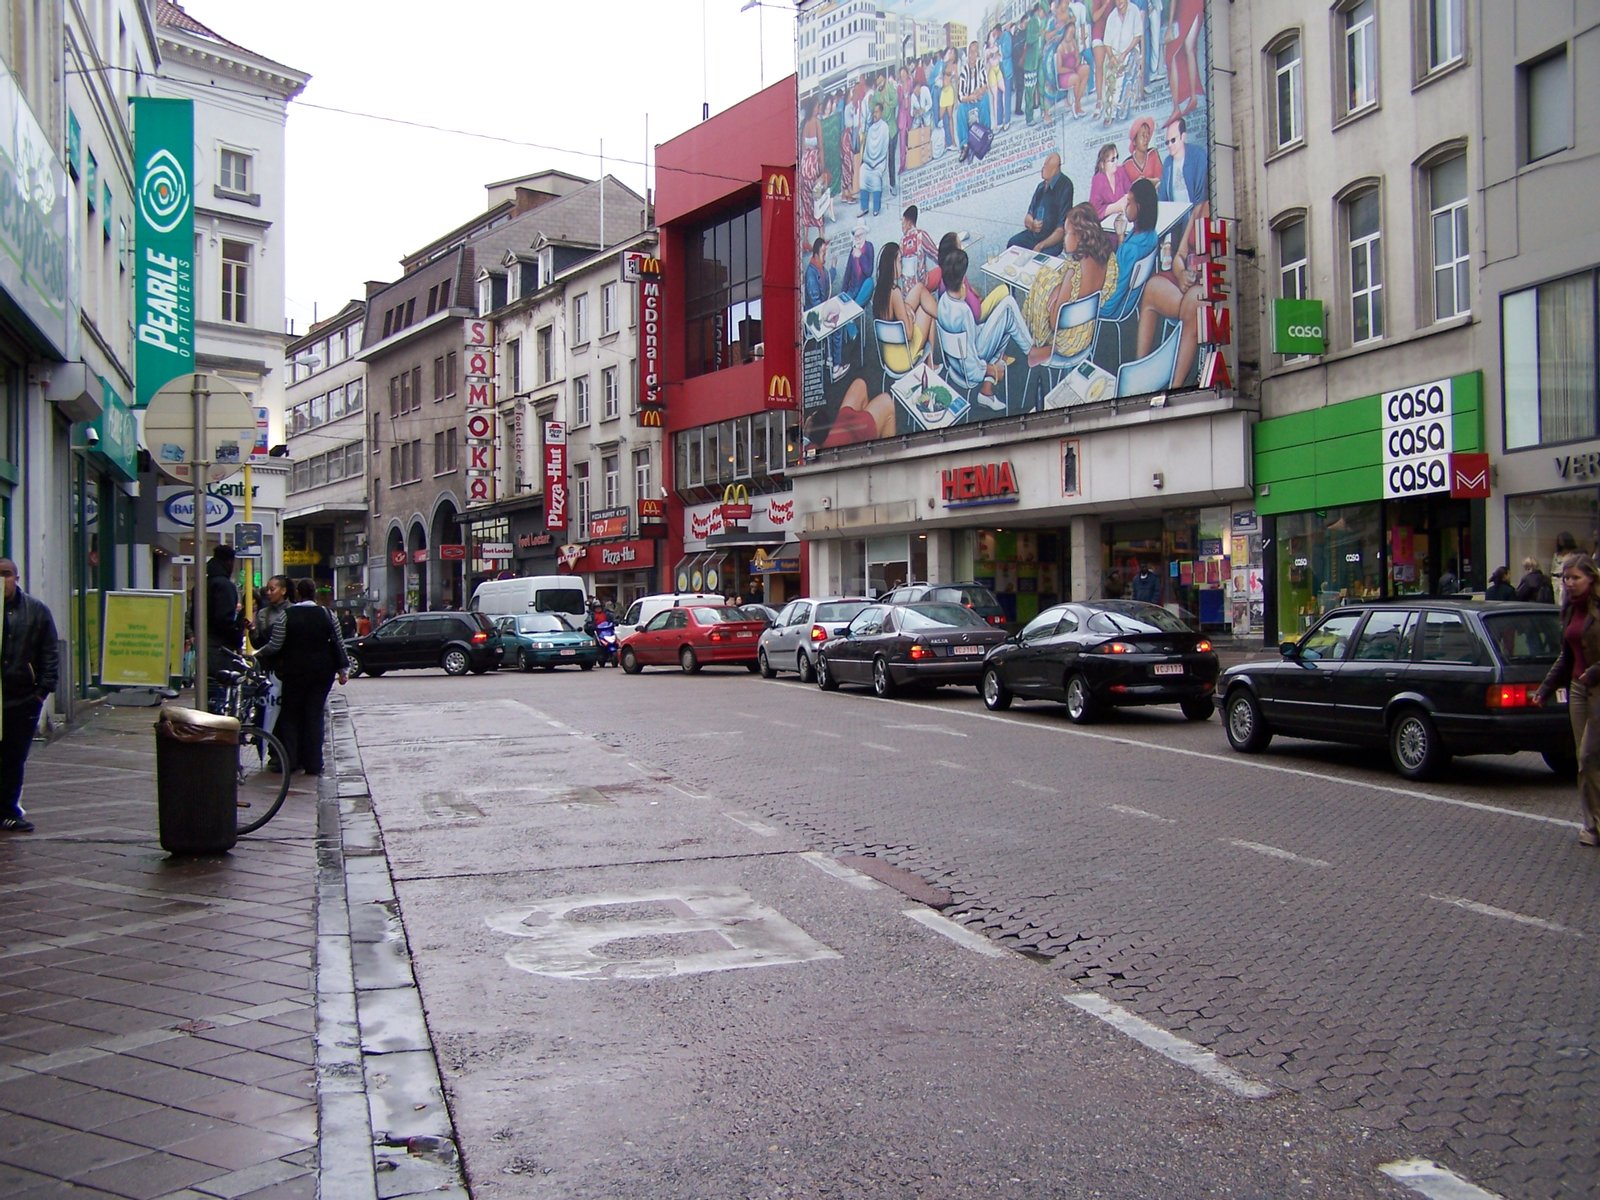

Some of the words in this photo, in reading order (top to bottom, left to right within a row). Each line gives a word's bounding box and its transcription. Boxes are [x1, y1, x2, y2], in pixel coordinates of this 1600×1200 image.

[139, 248, 178, 353] PEARLE
[179, 260, 190, 358] OPTICIENS
[1196, 217, 1232, 390] HEMA
[644, 283, 661, 401] McDonald's
[1288, 325, 1322, 338] casa
[468, 322, 489, 499] SAMOKA
[1388, 385, 1444, 421] casa
[1388, 422, 1445, 457] casa
[547, 448, 562, 479] Hut
[942, 461, 1018, 500] HEMA
[1389, 459, 1446, 493] casa
[207, 481, 260, 497] Centr
[548, 483, 565, 527] Pizza
[174, 504, 223, 515] BARLAY
[712, 506, 721, 519] Plu
[602, 548, 621, 565] Pizza
[622, 546, 635, 561] Hut
